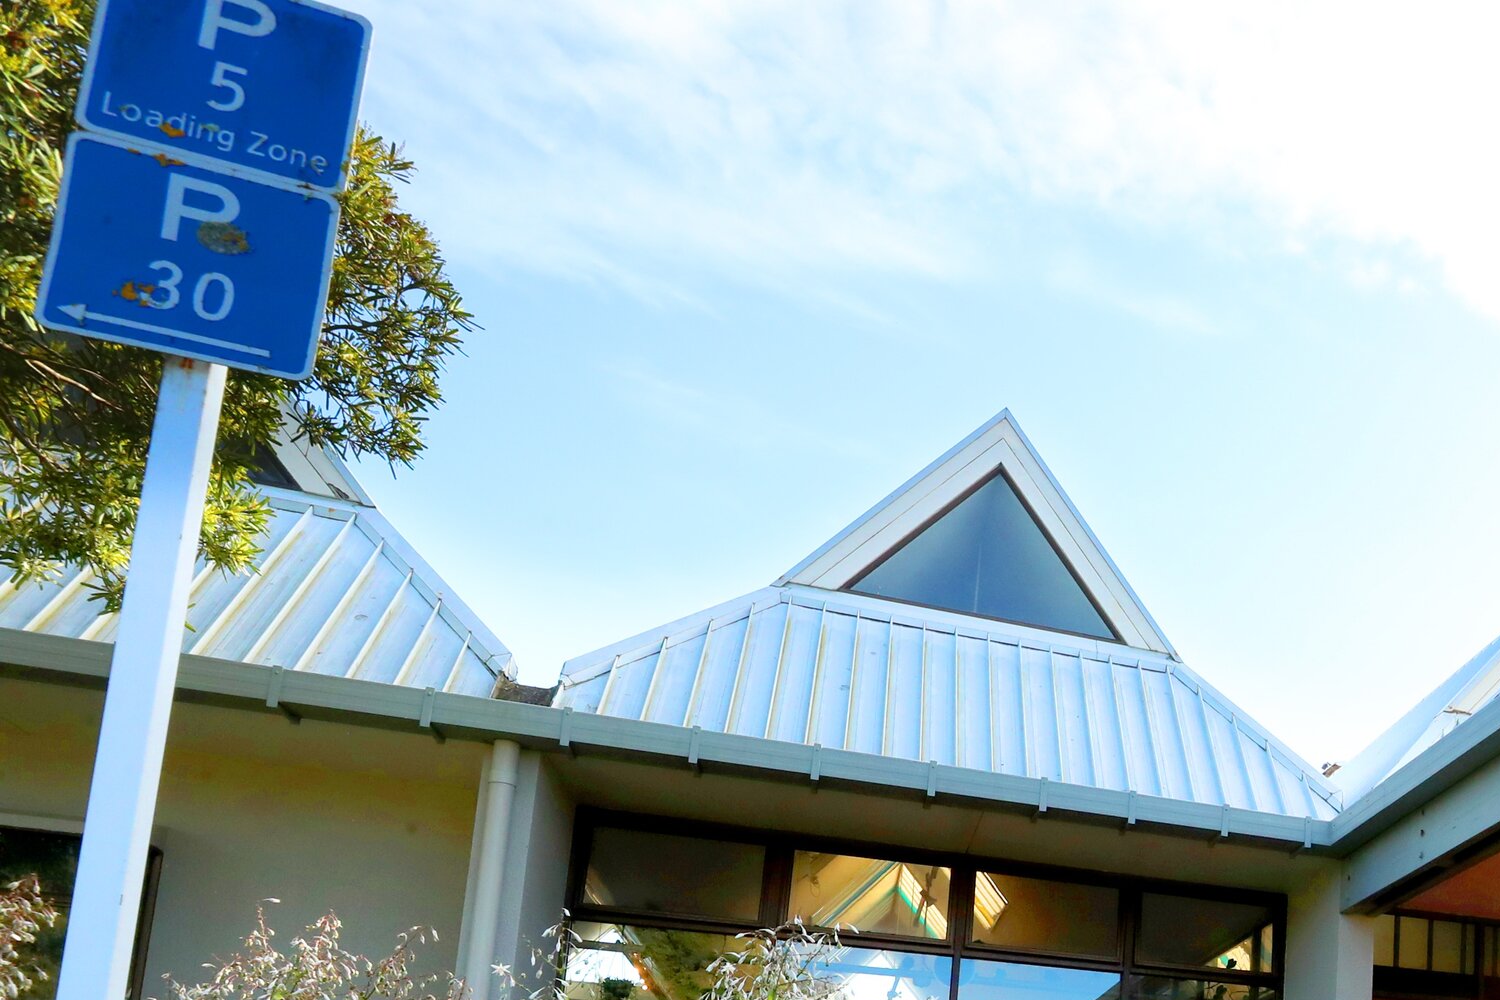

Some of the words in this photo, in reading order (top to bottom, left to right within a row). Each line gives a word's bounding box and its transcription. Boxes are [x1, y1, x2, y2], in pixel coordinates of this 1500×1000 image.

[198, 0, 277, 50] P
[206, 61, 249, 112] 5
[101, 91, 236, 152] Loading
[246, 131, 330, 175] Zone
[160, 172, 241, 241] P
[142, 259, 235, 322] 30
